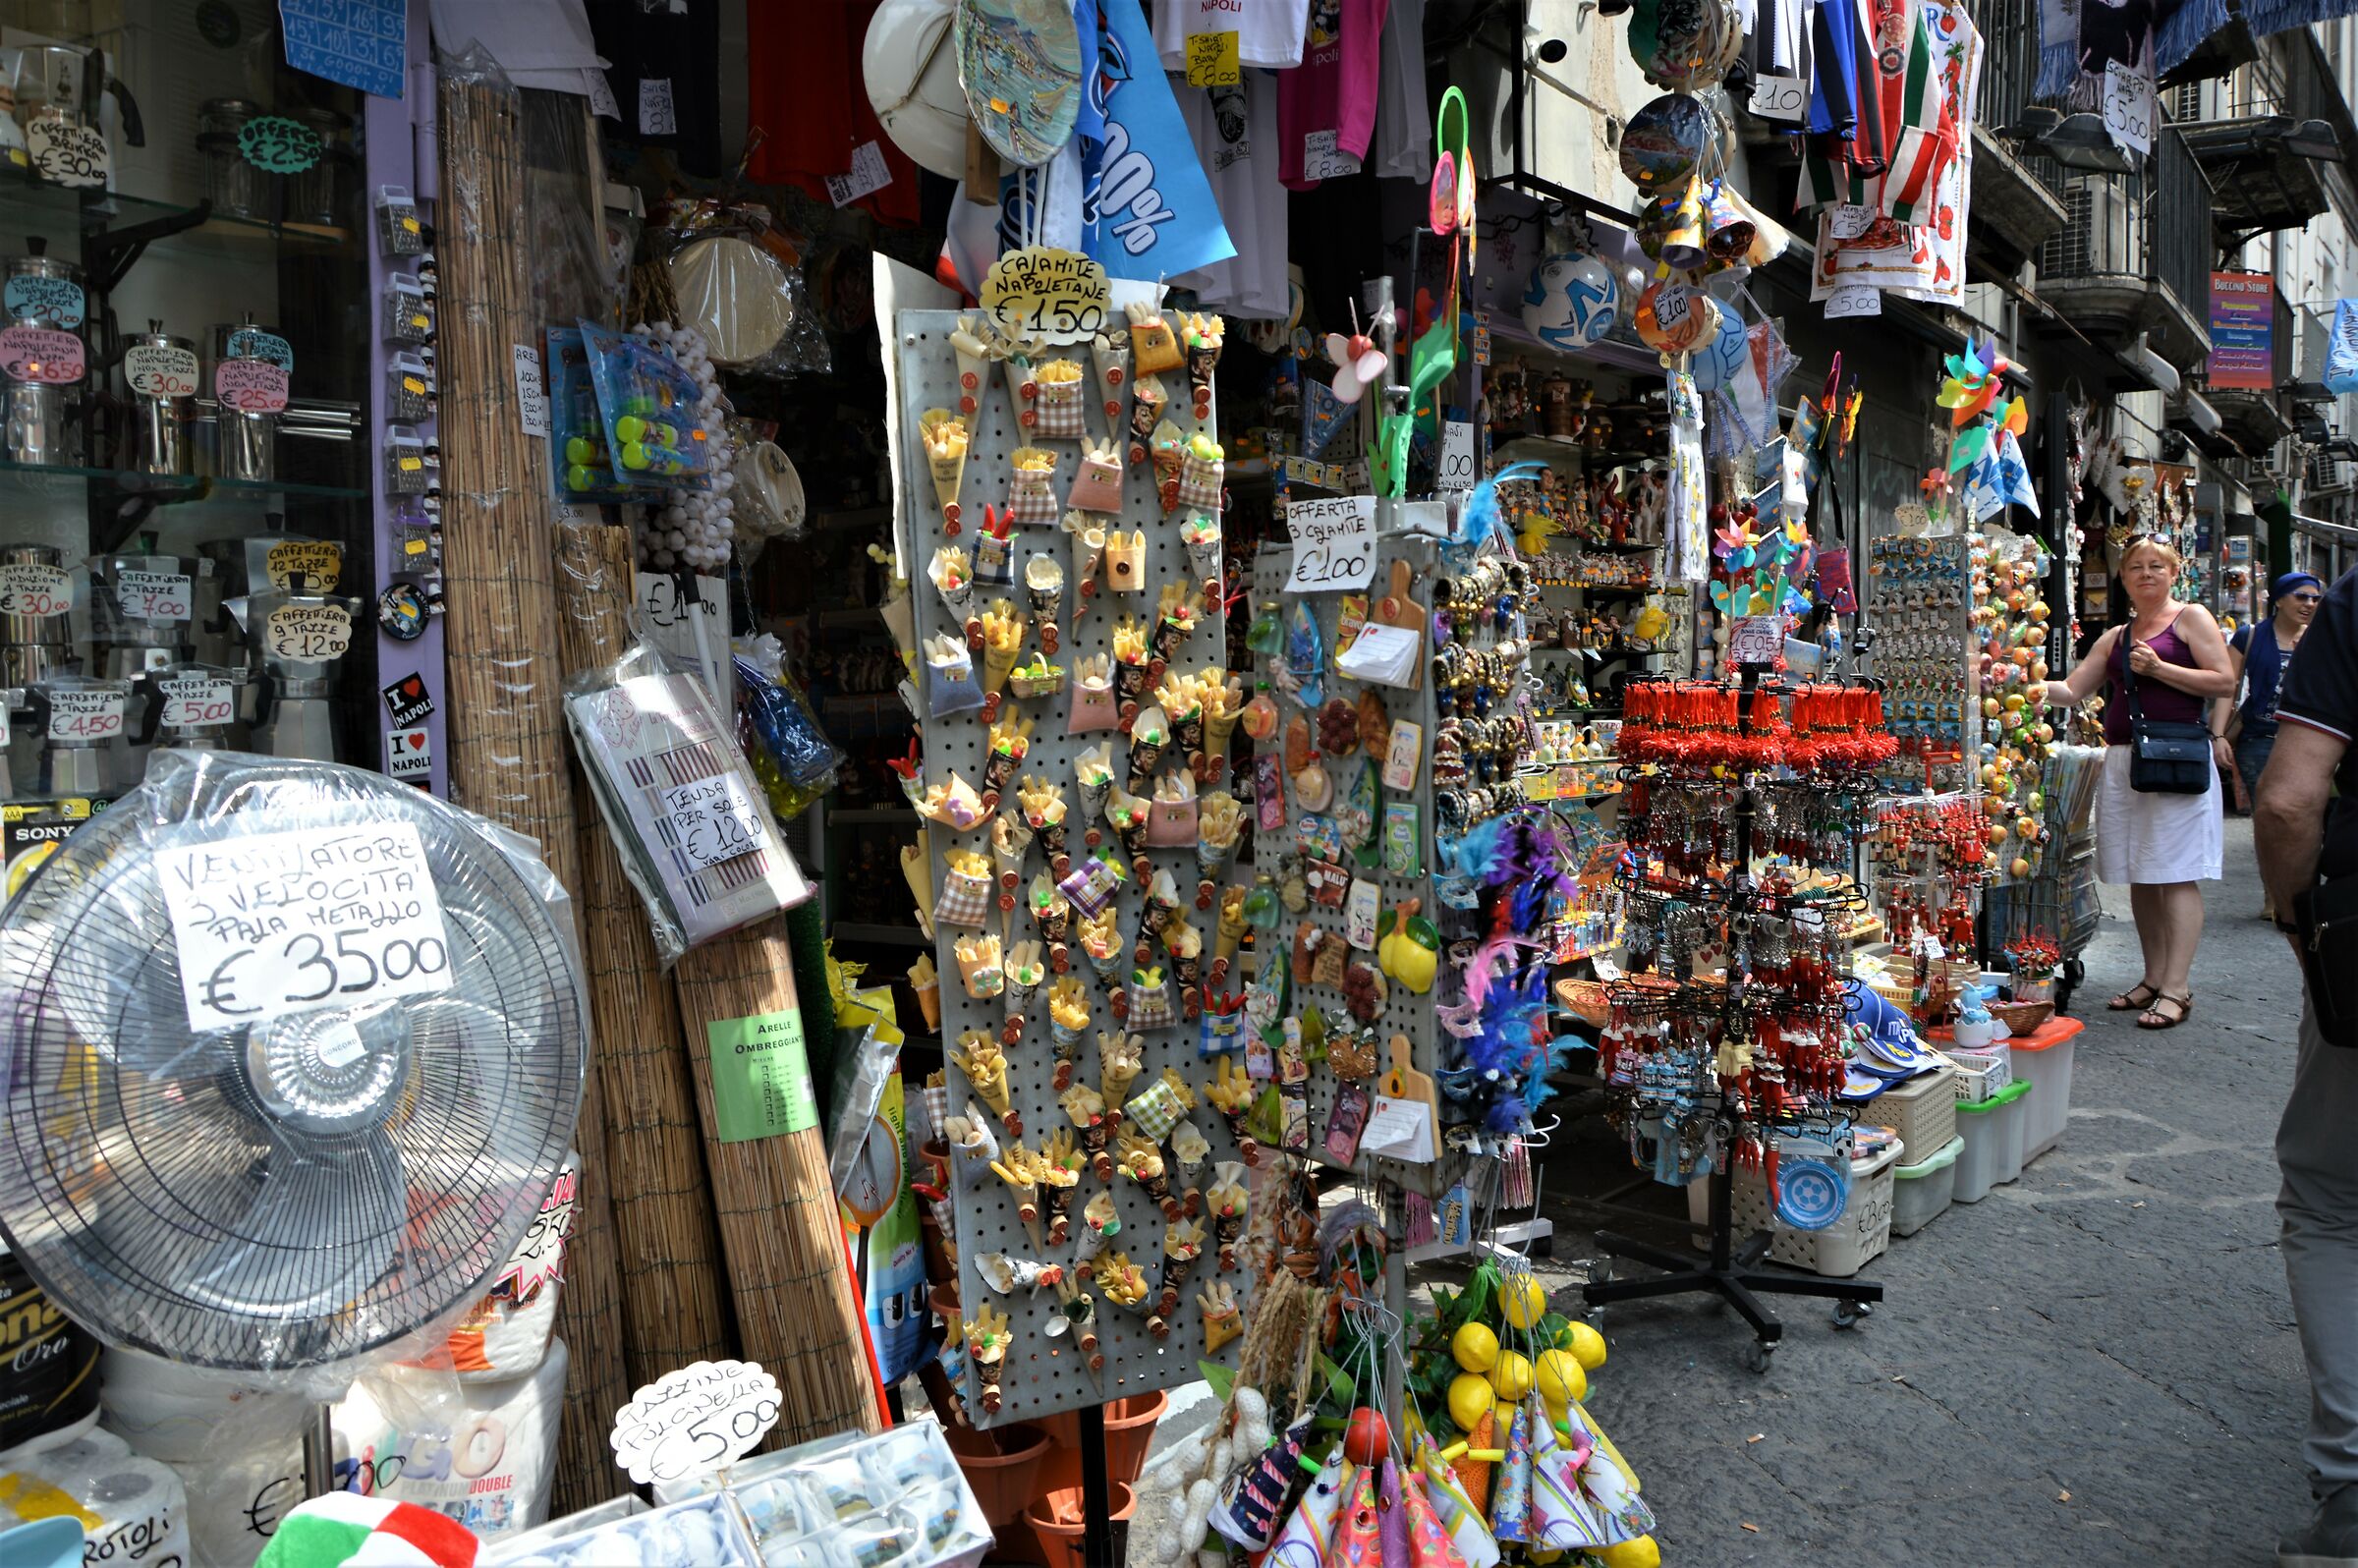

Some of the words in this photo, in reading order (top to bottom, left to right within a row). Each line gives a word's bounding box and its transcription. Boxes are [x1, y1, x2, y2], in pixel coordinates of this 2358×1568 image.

[996, 273, 1106, 302] NAPOLETANE
[1289, 499, 1357, 521] OFFERTA
[1306, 515, 1367, 544] CALAMITE
[268, 543, 339, 560] CAFFETTIERA
[270, 607, 348, 624] CAFFETTIERA
[184, 701, 231, 723] 5.00
[68, 714, 121, 737] 4.50
[666, 781, 726, 812] TENDA
[674, 811, 707, 828] PER
[712, 797, 748, 813] SOLE
[15, 825, 76, 842] SONY
[174, 835, 417, 891] VENTILATORE
[207, 916, 288, 944] PALA
[758, 1021, 792, 1035] ARELLE
[13, 1336, 68, 1372] Oro
[469, 1474, 513, 1494] DOUBLE
